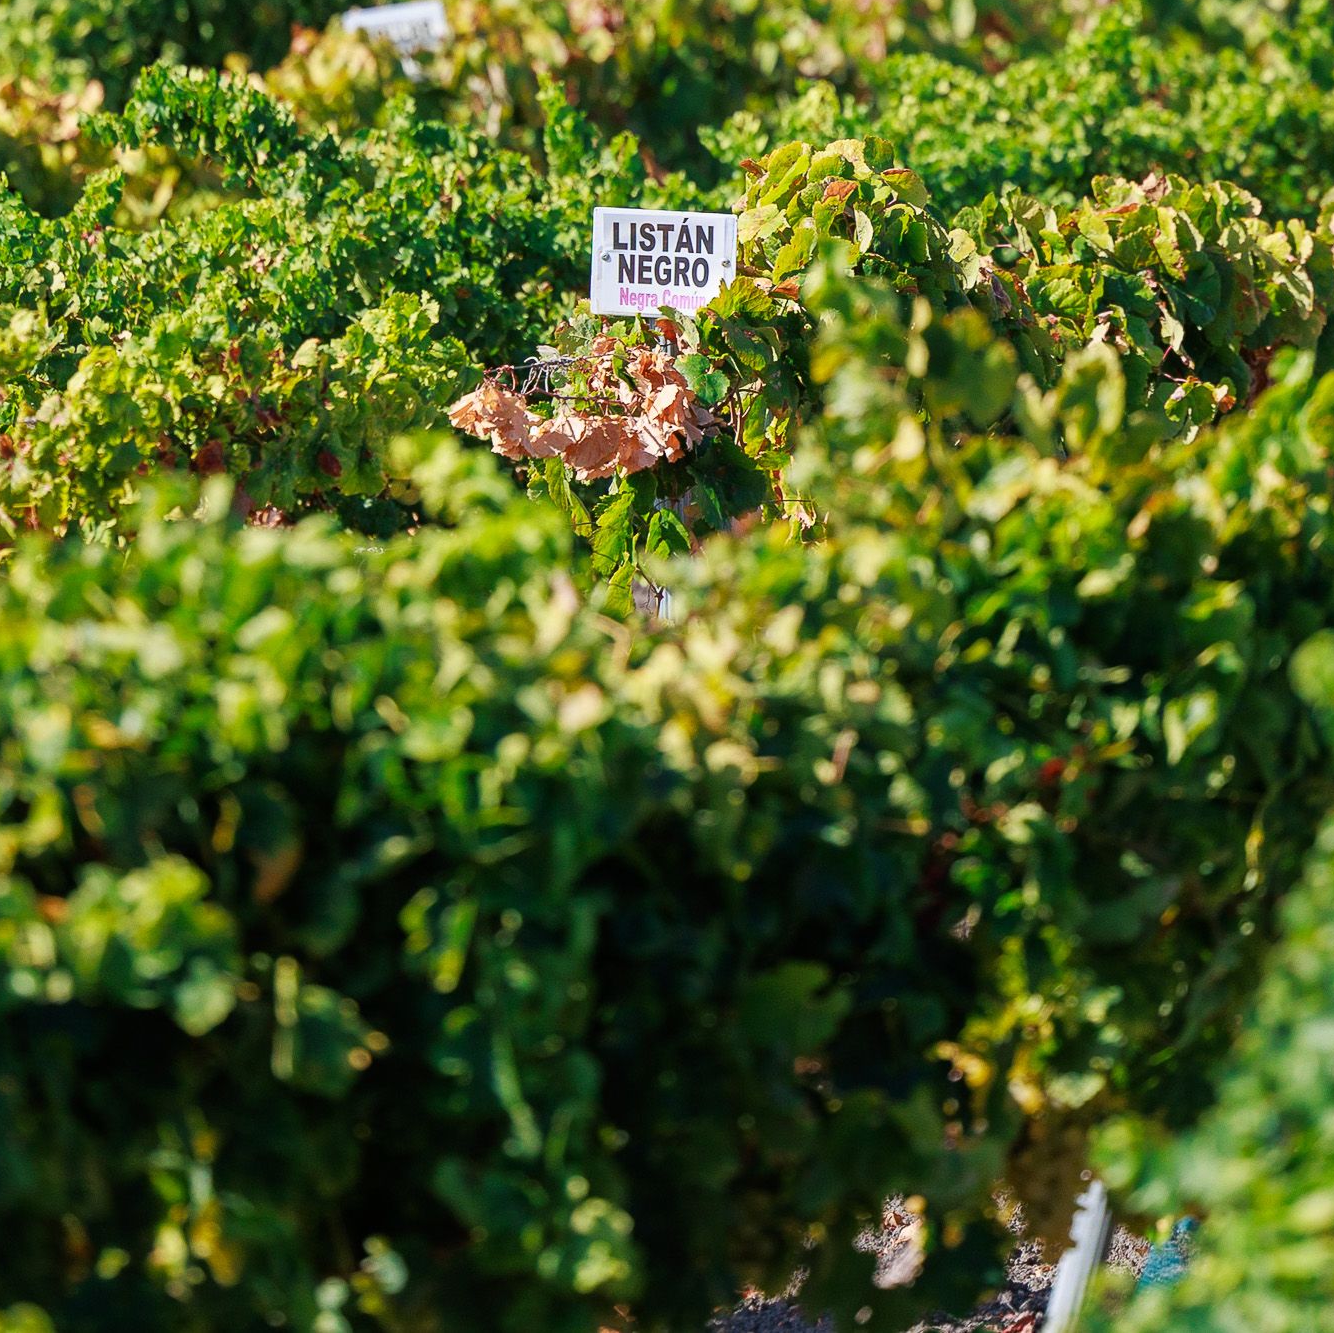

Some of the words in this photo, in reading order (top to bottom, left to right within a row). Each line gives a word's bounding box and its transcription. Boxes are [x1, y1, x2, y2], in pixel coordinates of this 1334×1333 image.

[613, 218, 714, 254] LISTÁN
[618, 254, 709, 288] NEGRO
[619, 287, 658, 312] Negra
